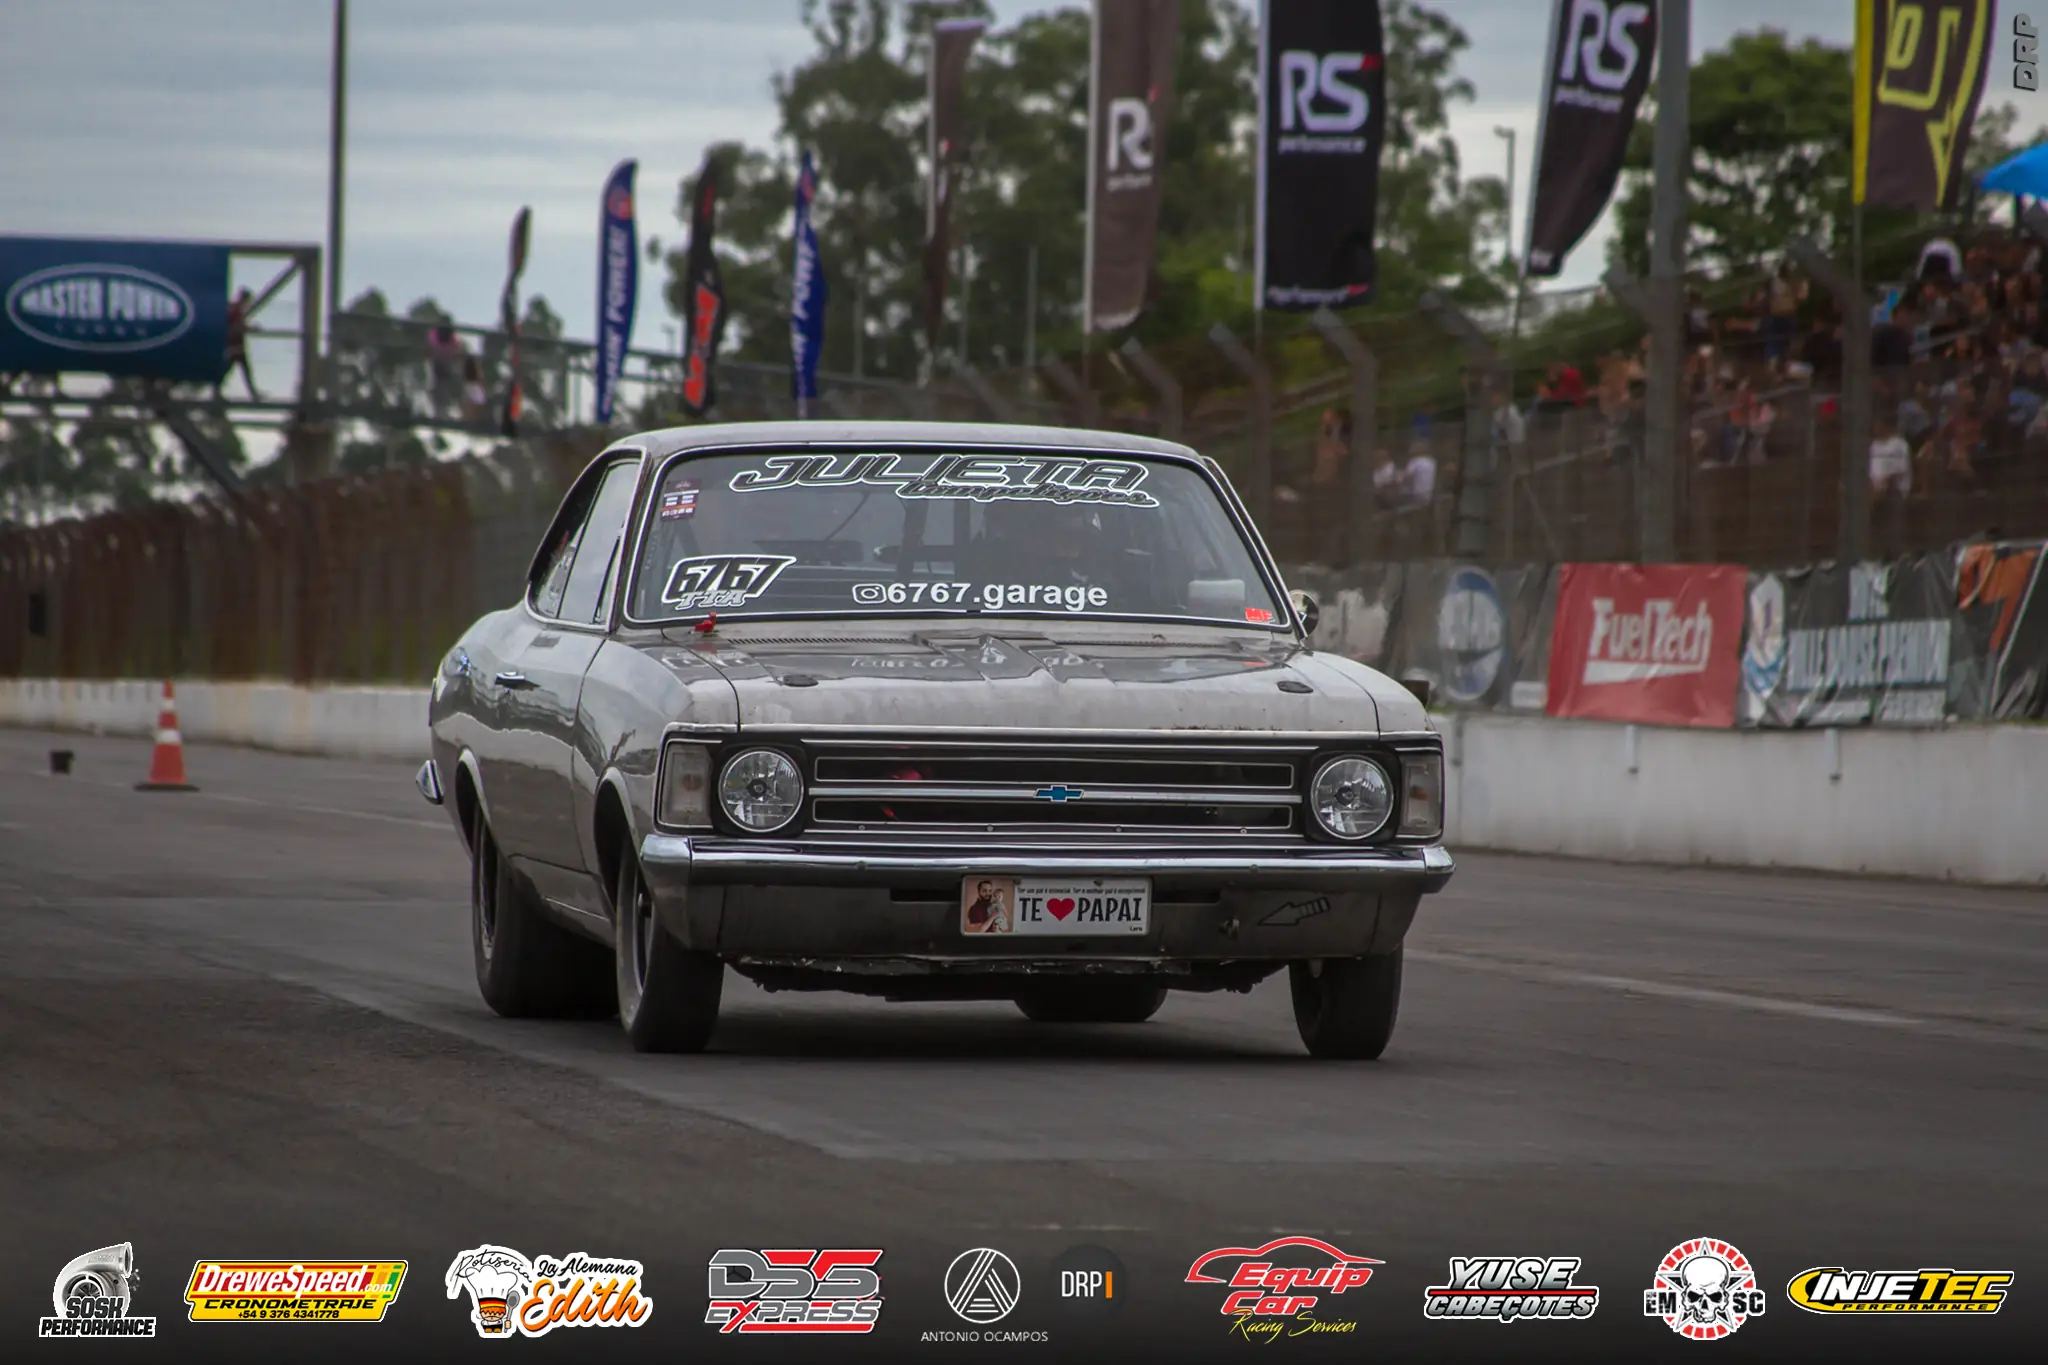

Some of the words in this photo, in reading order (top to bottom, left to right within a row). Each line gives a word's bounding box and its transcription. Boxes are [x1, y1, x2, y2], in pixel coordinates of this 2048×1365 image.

[1280, 51, 1370, 131] RS
[21, 279, 103, 319] MASTER
[107, 279, 181, 321] POWER
[729, 453, 1150, 493] JULIETA
[661, 554, 797, 604] 6767
[887, 582, 1108, 612] 6767.garage
[1588, 597, 1714, 672] FuelTech
[1019, 897, 1042, 922] TE
[1077, 897, 1142, 922] PAPAI
